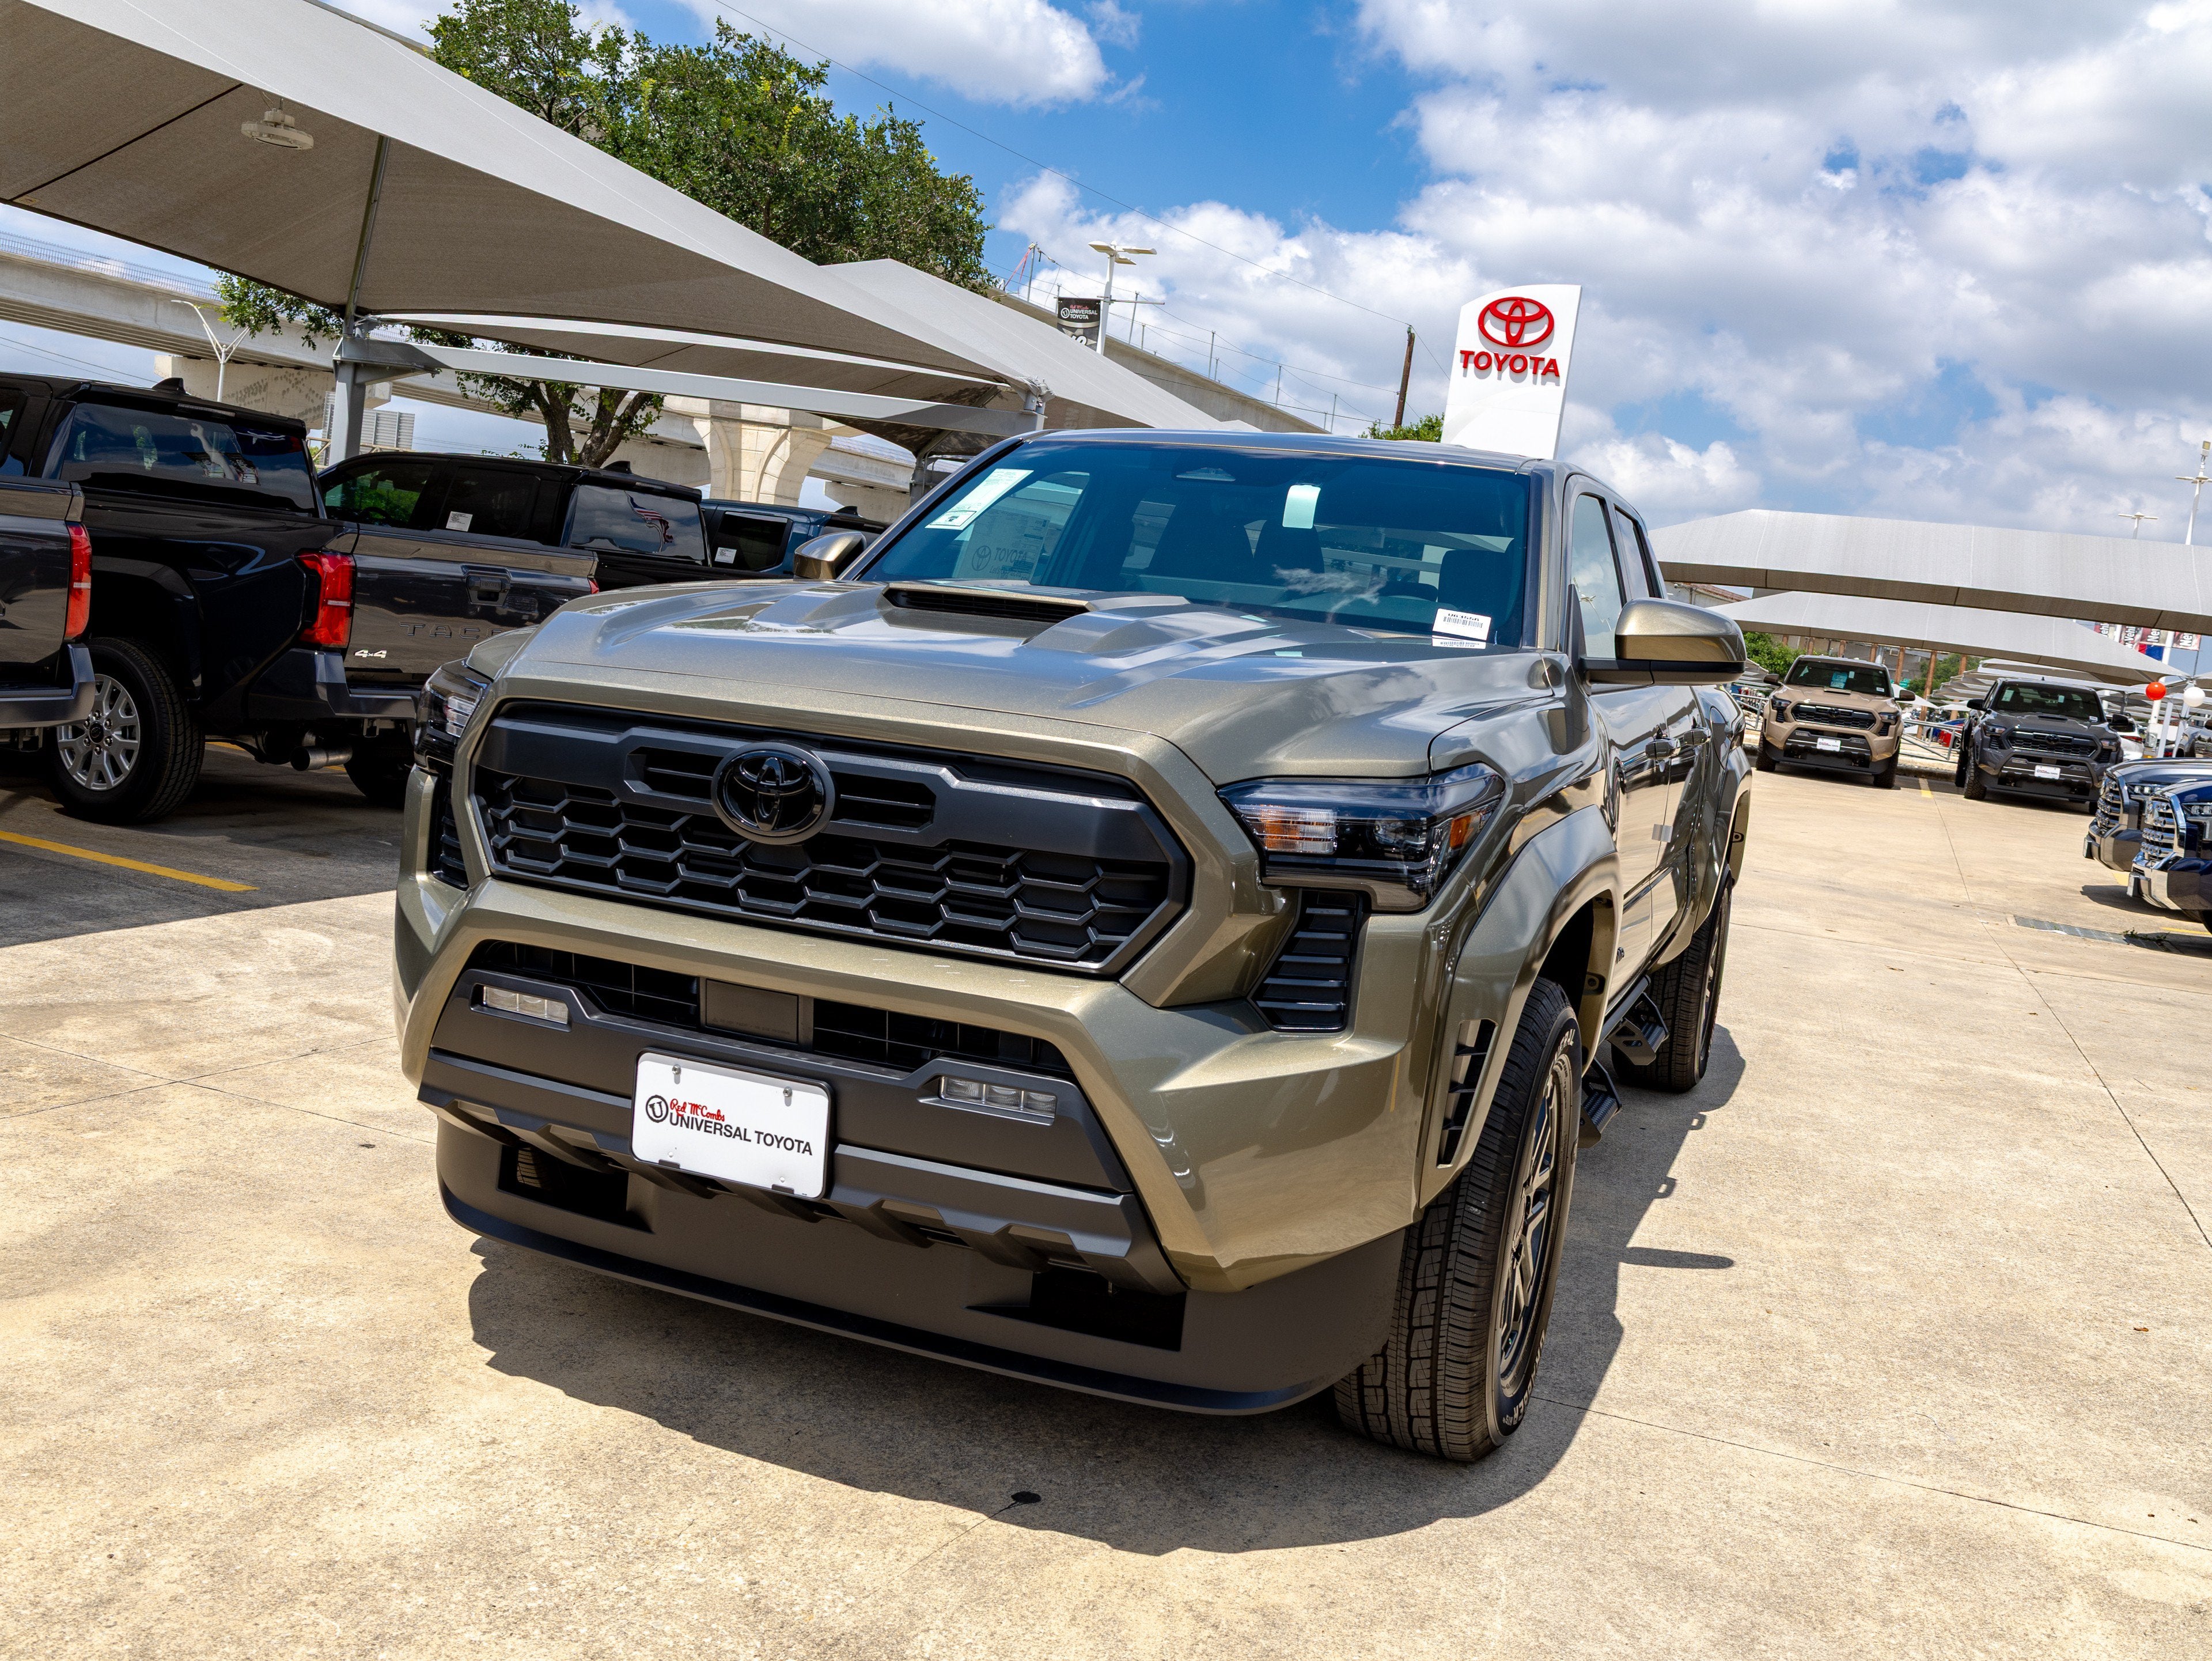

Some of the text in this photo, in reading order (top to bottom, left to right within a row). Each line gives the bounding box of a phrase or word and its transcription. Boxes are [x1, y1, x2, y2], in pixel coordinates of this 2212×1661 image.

[1460, 350, 1560, 377] TOYOTA
[994, 547, 1028, 563] TOYOTA
[2147, 629, 2160, 642] Ne
[2180, 633, 2192, 646] Ne
[354, 649, 387, 659] 4x4
[670, 1098, 686, 1117] Red
[688, 1102, 725, 1122] McCombs
[669, 1112, 813, 1155] UNIVERSAL TOYOTA
